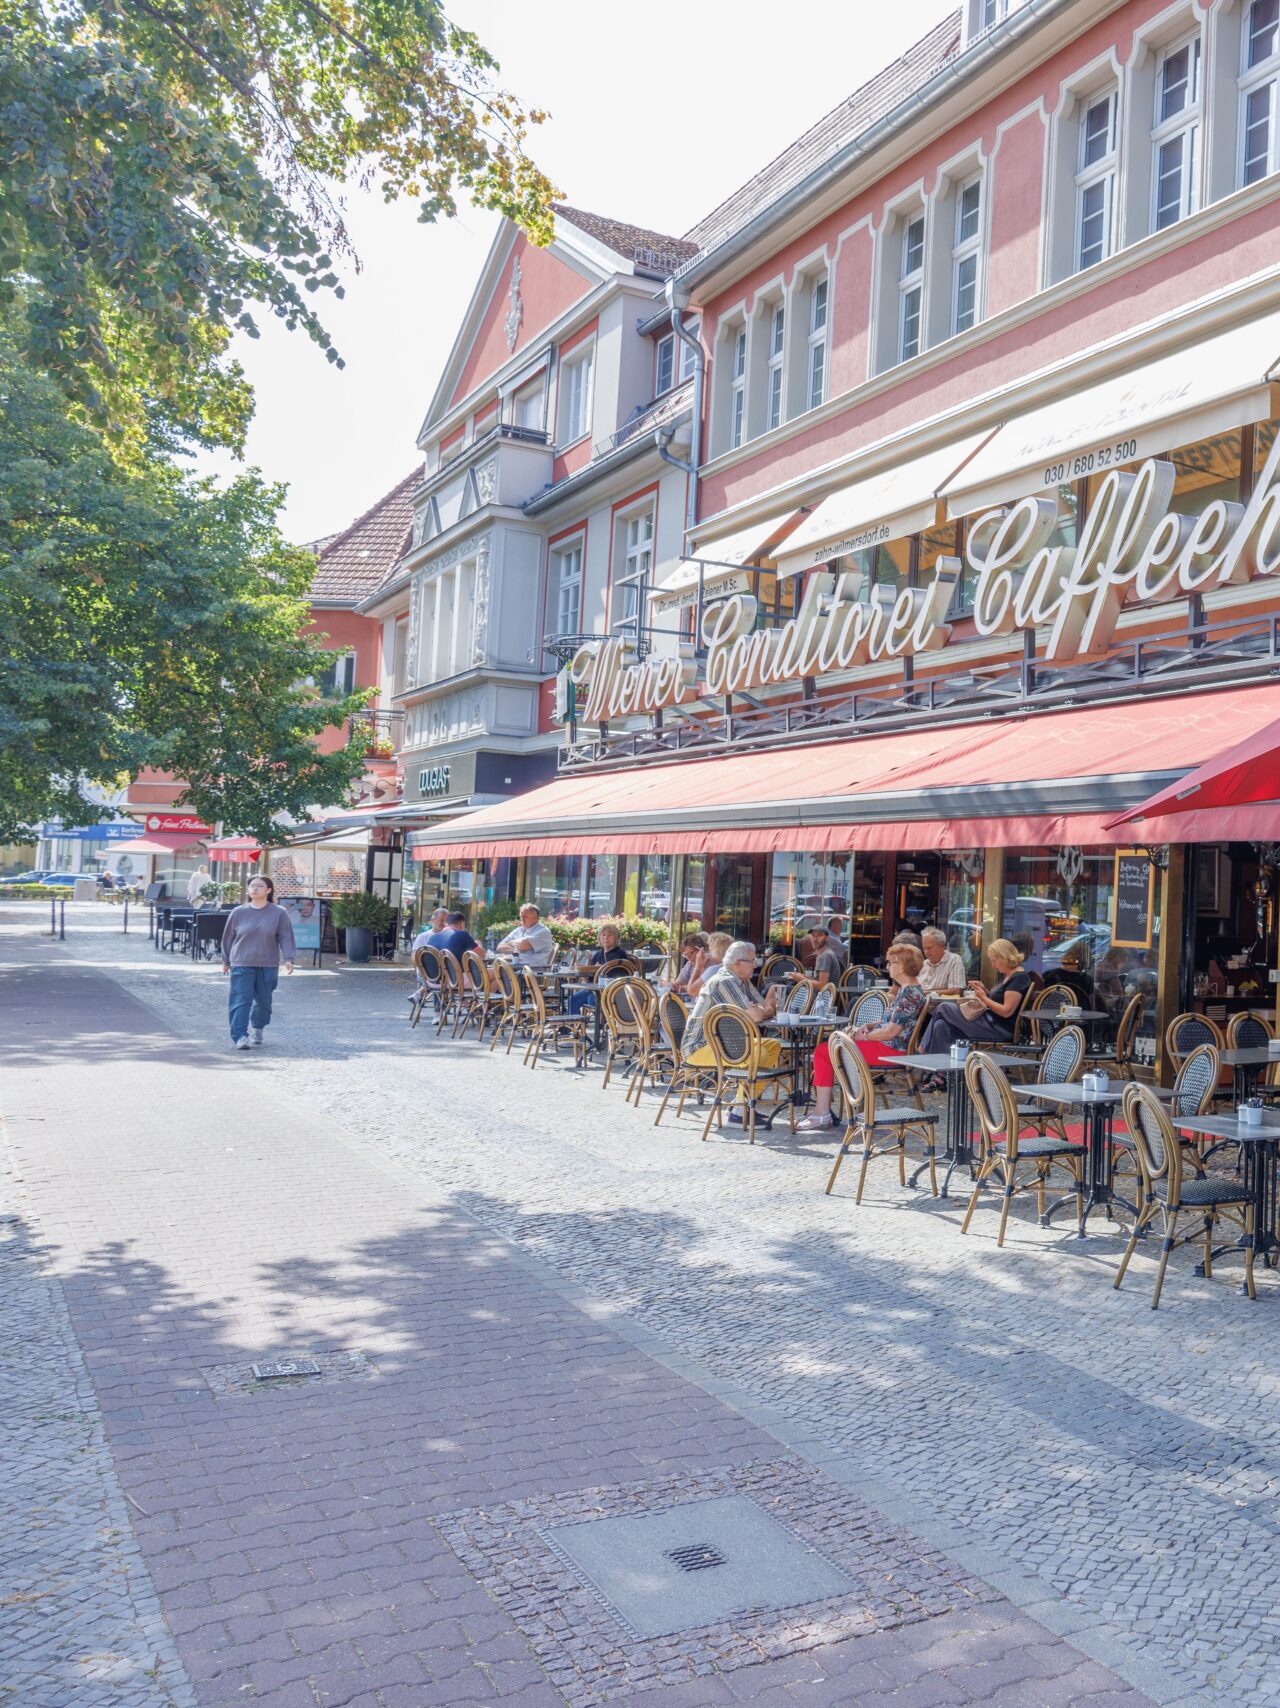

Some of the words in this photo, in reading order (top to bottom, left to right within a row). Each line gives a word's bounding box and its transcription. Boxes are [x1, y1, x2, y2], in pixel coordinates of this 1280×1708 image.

[1044, 466, 1064, 485] 030
[1066, 464, 1072, 478] /
[1073, 455, 1094, 475] 680
[1097, 450, 1111, 468] 52
[1114, 439, 1137, 462] 500
[814, 524, 890, 562] zahn-wilmersdorf.de
[571, 635, 692, 724] Wiener
[702, 556, 960, 697] Conditorei
